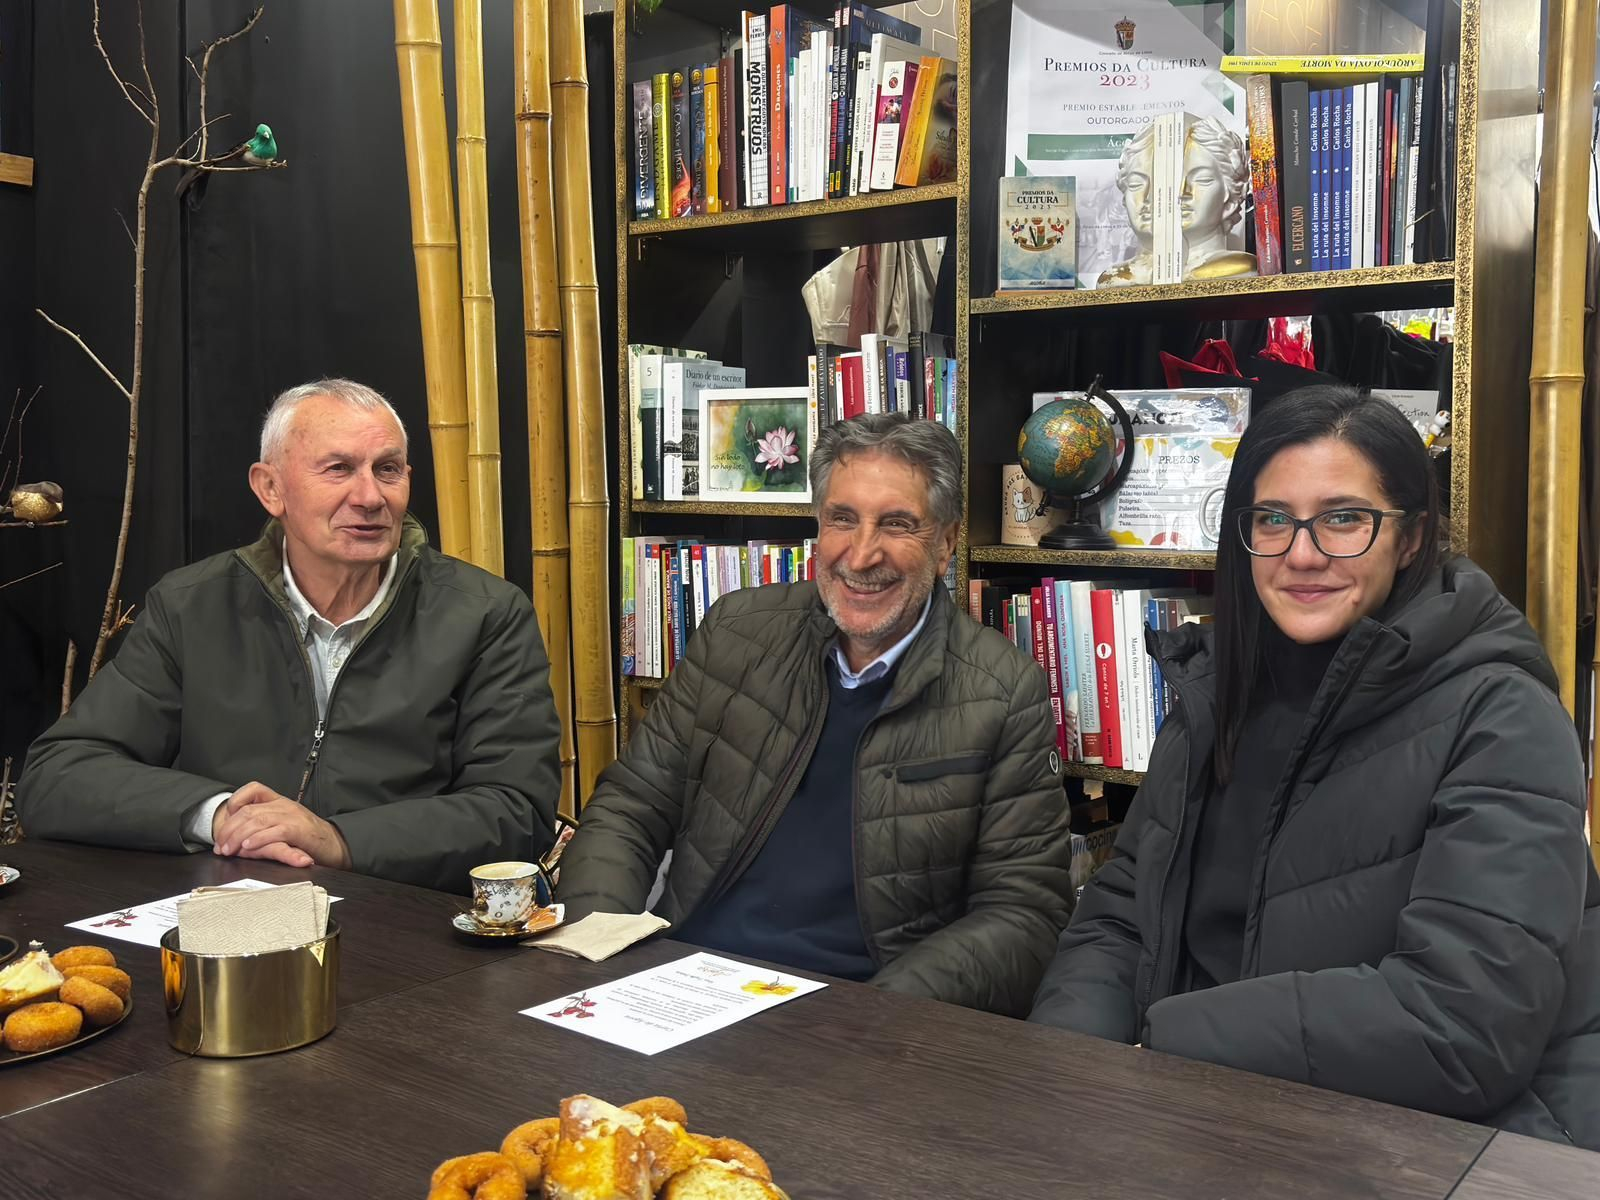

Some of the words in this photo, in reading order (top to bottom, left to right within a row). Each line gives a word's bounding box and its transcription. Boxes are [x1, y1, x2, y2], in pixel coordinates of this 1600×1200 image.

[1045, 57, 1107, 72] PREMIOS
[1112, 63, 1131, 73] DA
[1137, 57, 1207, 72] CULTURA
[1300, 59, 1333, 68] MORTE
[1347, 59, 1417, 69] ARQUEOLOXÍA
[1099, 74, 1150, 91] 2023
[750, 61, 762, 155] MONSTRUOS
[1063, 104, 1096, 112] PREMIO
[1099, 101, 1185, 112] ESTABLEEMENTOS
[1344, 104, 1352, 125] Rocha
[1087, 116, 1150, 125] OUTORGADO
[1333, 105, 1341, 127] Rocha
[674, 113, 682, 137] CASA
[1333, 129, 1341, 150] Carlos
[1344, 127, 1352, 148] Carlos
[639, 111, 649, 198] DIVERGENTE
[674, 149, 682, 180] HADES
[1017, 196, 1059, 204] CULTURA
[1312, 249, 1319, 258] La
[1322, 249, 1329, 258] La
[1333, 248, 1340, 257] La
[1343, 248, 1350, 256] La
[646, 367, 653, 377] 5
[686, 370, 703, 379] Diario
[705, 372, 711, 381] de
[721, 374, 742, 383] escritor
[1158, 455, 1200, 464] PREZOS
[1047, 631, 1057, 667] ARGUMENTARIO
[1131, 637, 1139, 655] Marta
[1049, 668, 1058, 694] FEMINISTA
